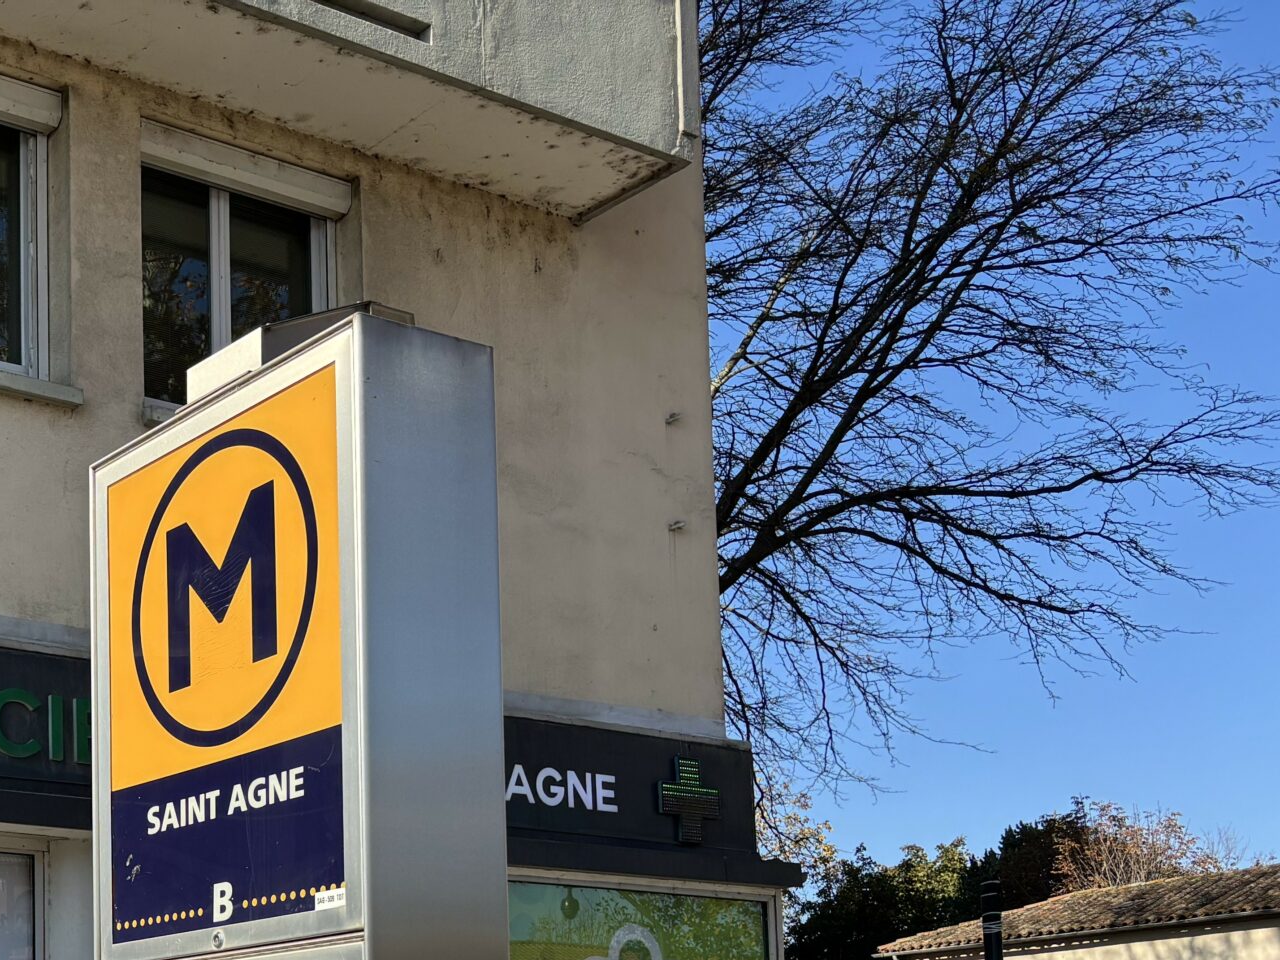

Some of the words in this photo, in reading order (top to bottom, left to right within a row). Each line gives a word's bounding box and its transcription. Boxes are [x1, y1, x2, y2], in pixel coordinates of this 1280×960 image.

[166, 480, 278, 694] M
[147, 790, 220, 835] SAINT
[227, 766, 304, 815] AGNE
[505, 764, 618, 812] AGNE
[212, 881, 234, 922] B
